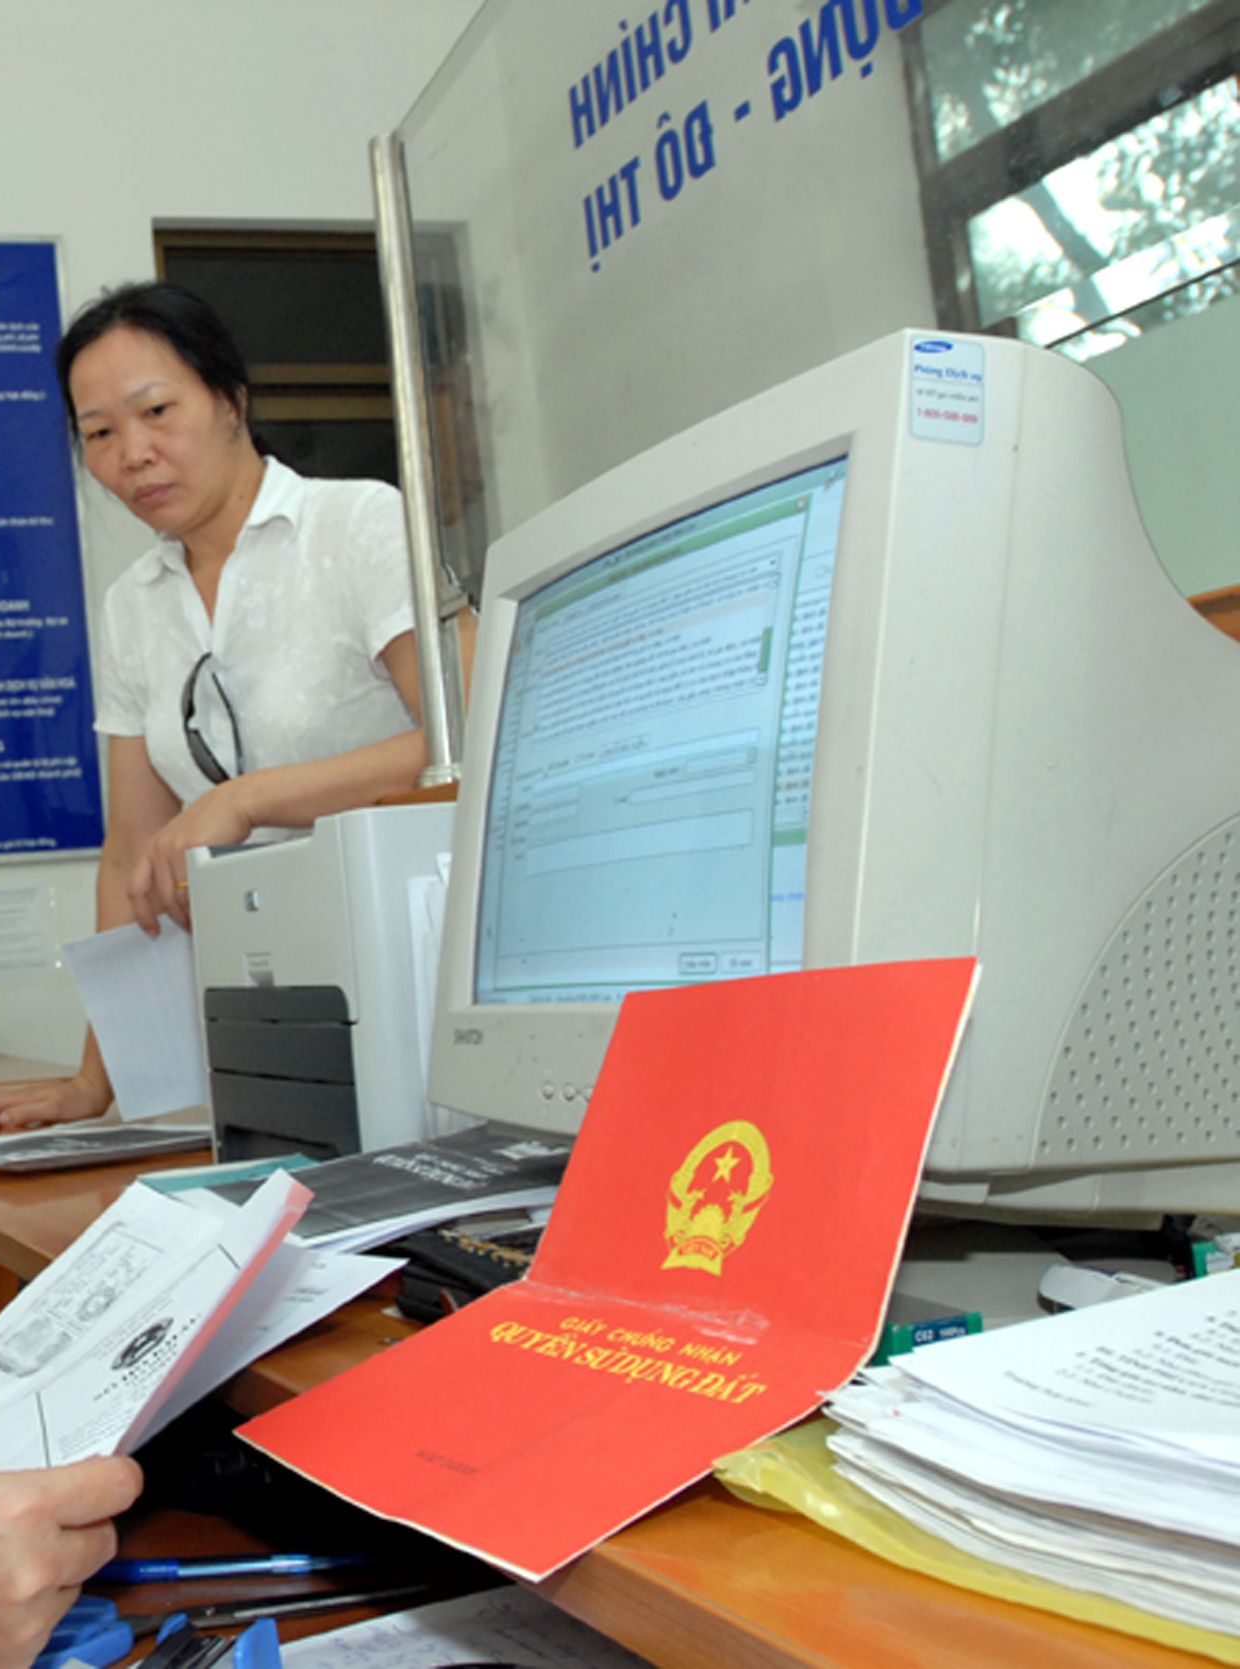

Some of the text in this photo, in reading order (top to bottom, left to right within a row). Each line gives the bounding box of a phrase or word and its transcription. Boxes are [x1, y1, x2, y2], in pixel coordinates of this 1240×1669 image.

[490, 1320, 588, 1359] QUYỀN
[608, 1352, 701, 1390] DỤNG
[686, 1372, 768, 1404] ĐẤT
[560, 1317, 743, 1366] GIẤY CHỨNG NHẬN
